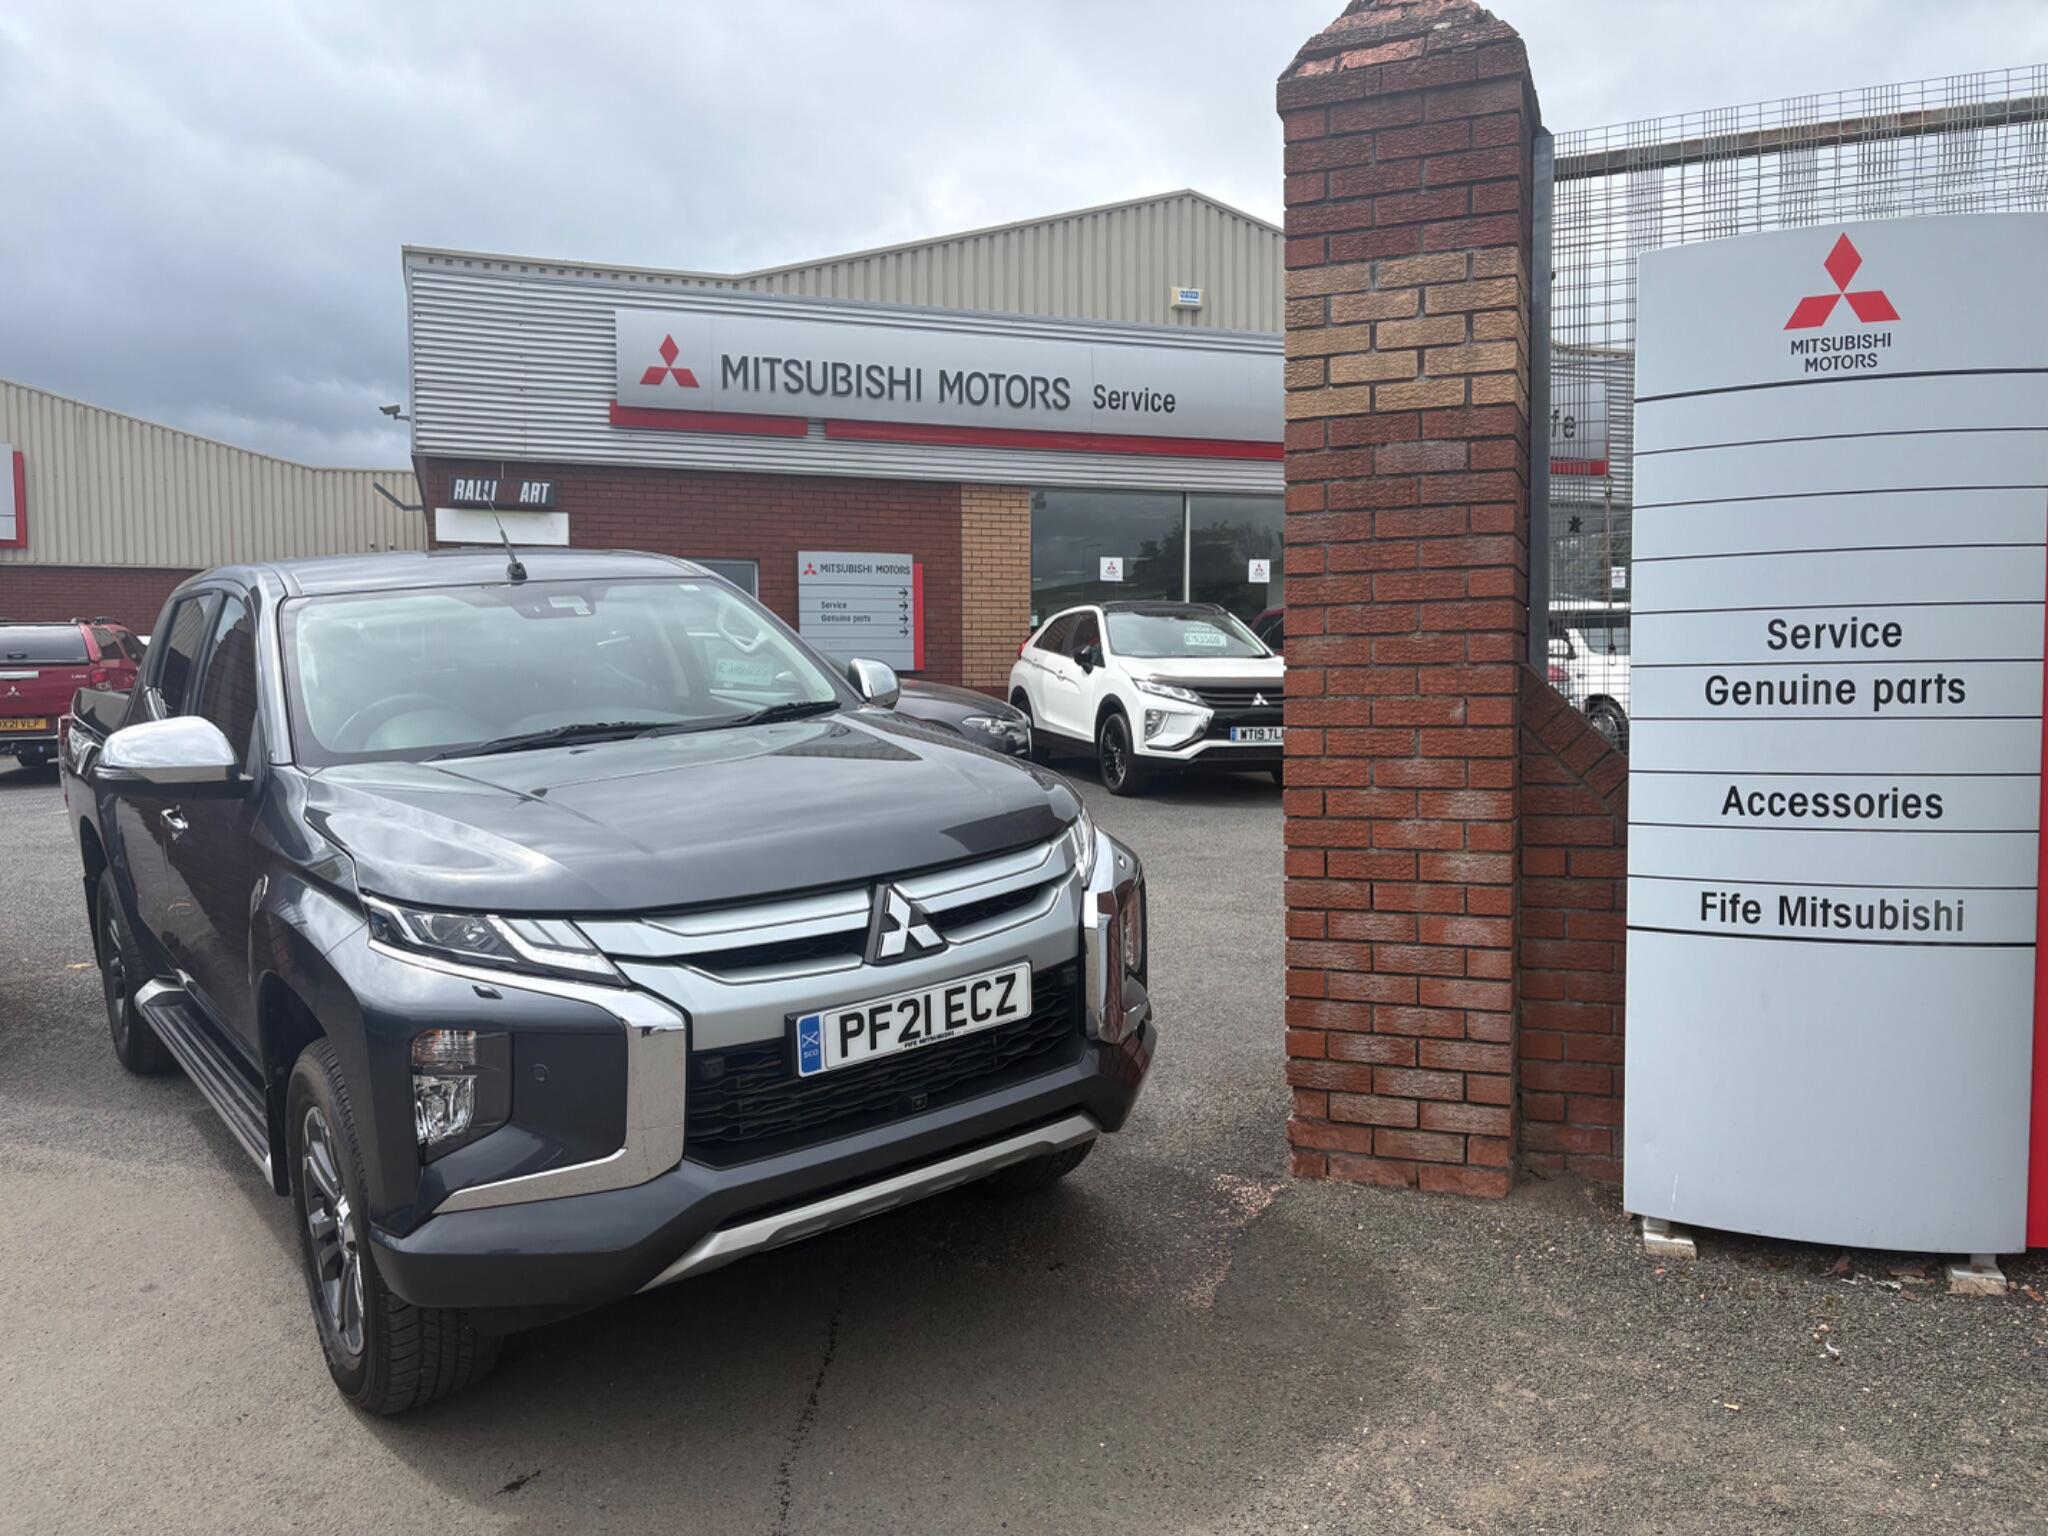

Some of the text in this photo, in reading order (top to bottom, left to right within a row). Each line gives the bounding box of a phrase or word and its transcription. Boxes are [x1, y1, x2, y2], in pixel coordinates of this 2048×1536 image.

[1790, 332, 1892, 356] MITSUBISHI
[1804, 353, 1879, 373] MOTORS
[720, 353, 1177, 414] MITSUBISHI MOTORS Service
[519, 481, 551, 503] ART
[820, 563, 911, 575] MITSUBISHI MOTORS
[821, 601, 848, 609] Service
[821, 614, 872, 624] Genuine parts
[1766, 616, 1904, 651] Service
[1704, 673, 1967, 712] Genuine parts
[1721, 785, 1944, 820] Accessories
[1700, 891, 1965, 932] Fife Mitsubishi
[838, 972, 1018, 1059] PF21 ECZ
